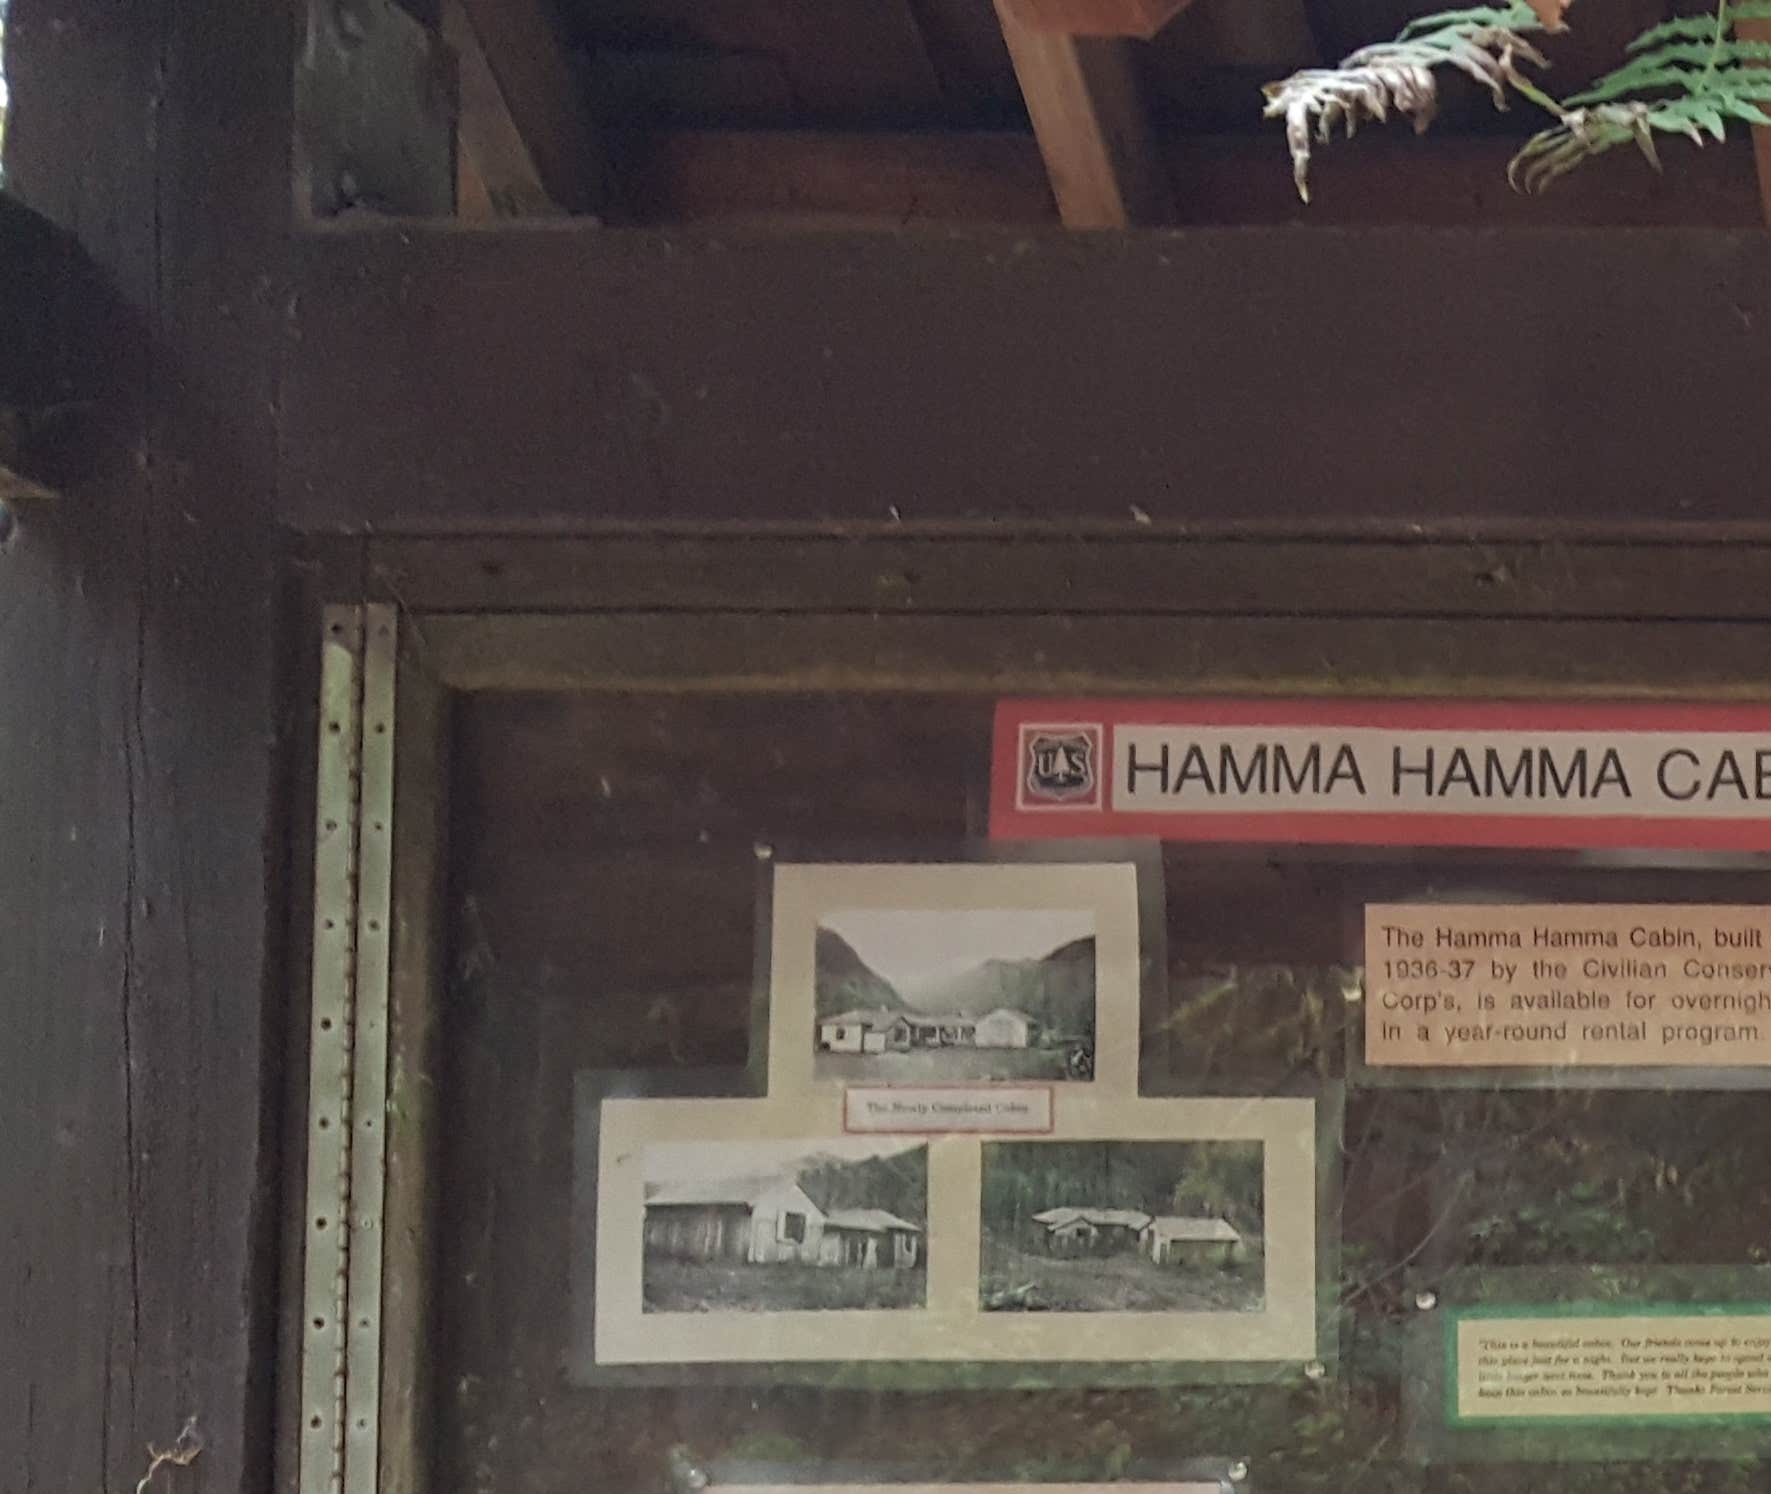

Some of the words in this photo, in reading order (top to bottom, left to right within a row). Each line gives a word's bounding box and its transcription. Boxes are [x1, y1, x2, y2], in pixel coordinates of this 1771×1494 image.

[1126, 743, 1367, 796] HAMMA
[1391, 745, 1632, 799] HAMMA
[1380, 925, 1424, 949] The
[1435, 926, 1522, 949] Hamma
[1532, 925, 1618, 948] Hamma
[1629, 925, 1702, 951] Cabin,
[1714, 927, 1763, 949] built
[1383, 956, 1476, 981] 1936-37
[1487, 956, 1517, 985] by
[1532, 957, 1567, 980] the
[1582, 956, 1667, 979] Civilian
